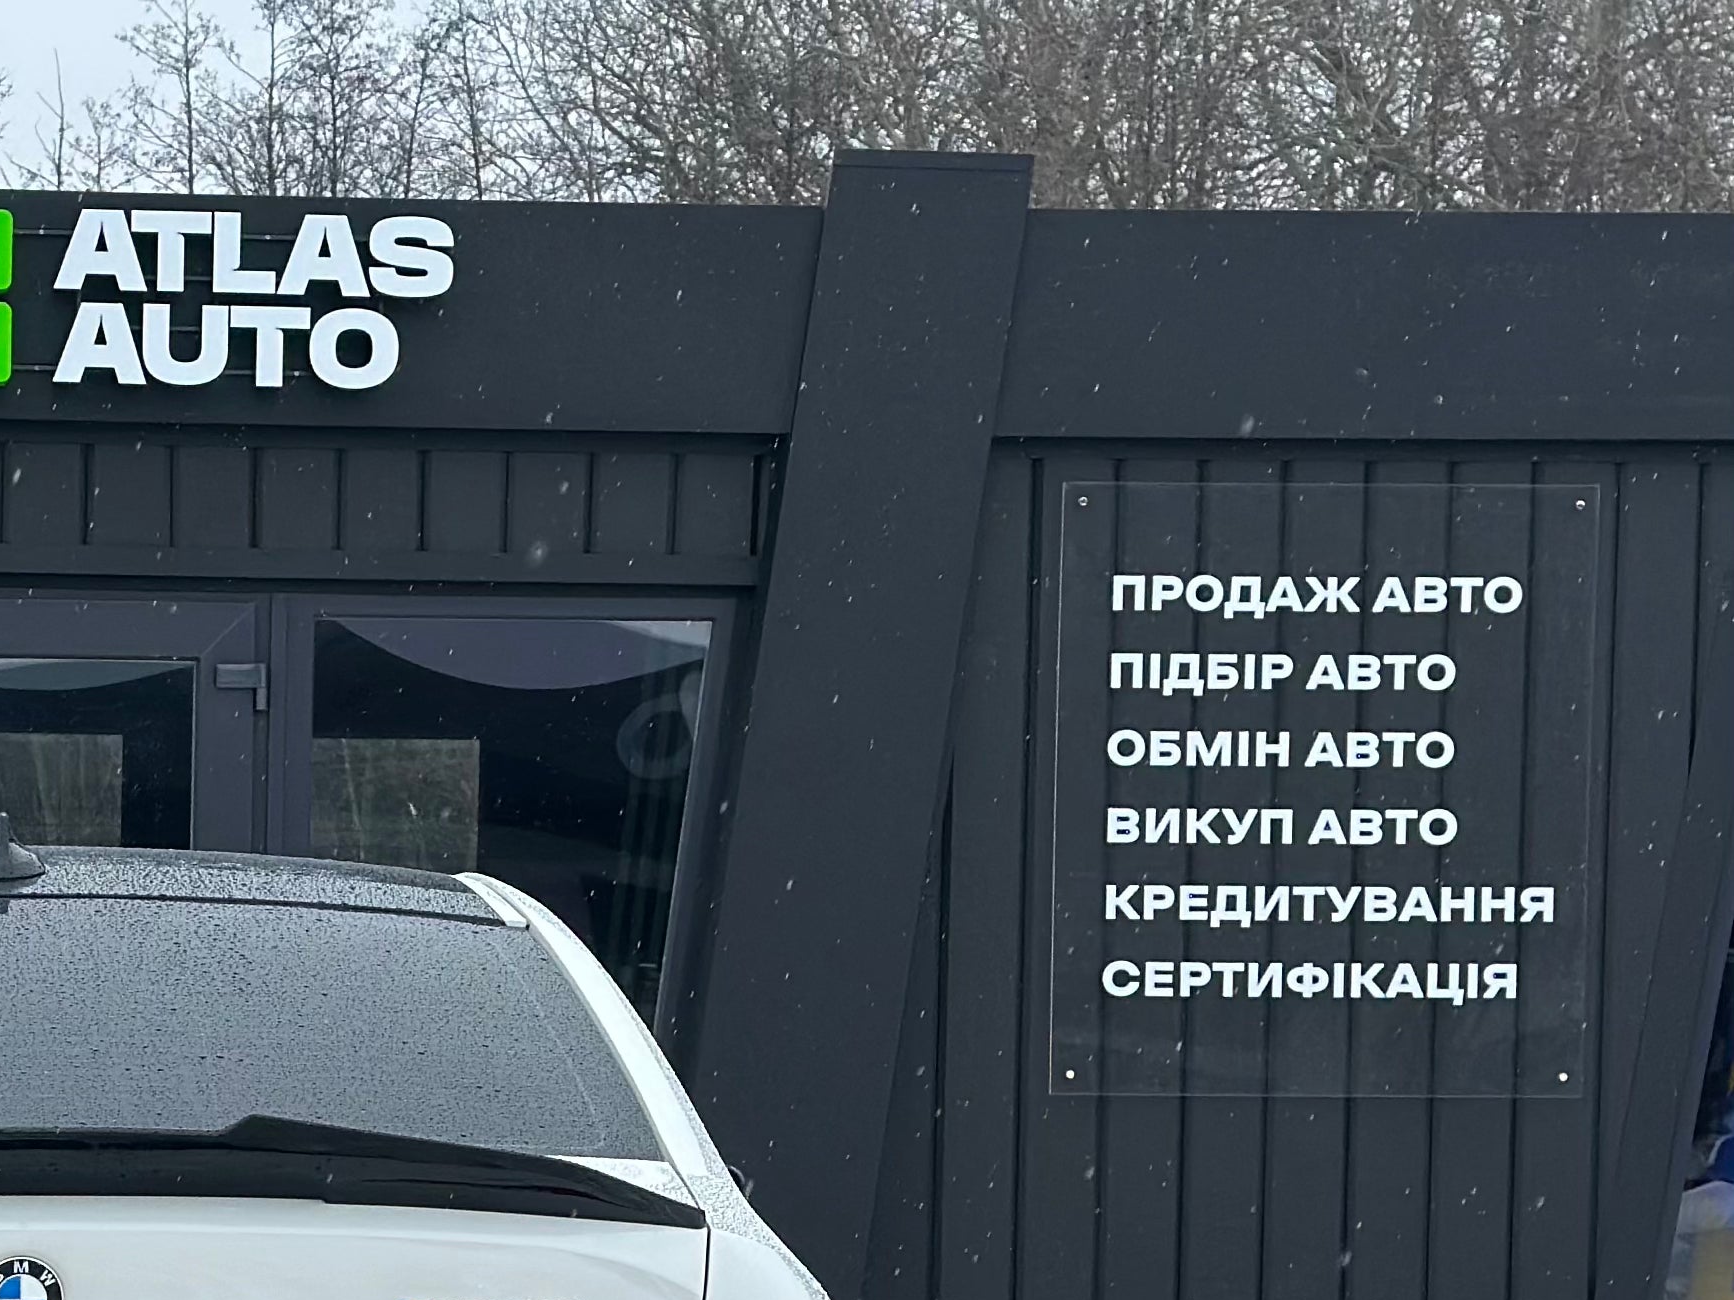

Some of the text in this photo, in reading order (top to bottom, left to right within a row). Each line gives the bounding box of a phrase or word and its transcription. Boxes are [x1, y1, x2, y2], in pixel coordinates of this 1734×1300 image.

[54, 209, 454, 297] ATLAS
[53, 303, 398, 389] AUTO
[1113, 575, 1522, 619] ПРОДАЖ АВТО
[1111, 653, 1456, 696] ПІДБІР АВТО
[1108, 730, 1454, 768] ОБМІН АВТО
[1107, 808, 1457, 845] ВИКУП АВТО
[1106, 885, 1554, 928] КРЕДИТУВАННЯ
[1102, 961, 1517, 1005] СЕРТИФІКАЦІЯ
